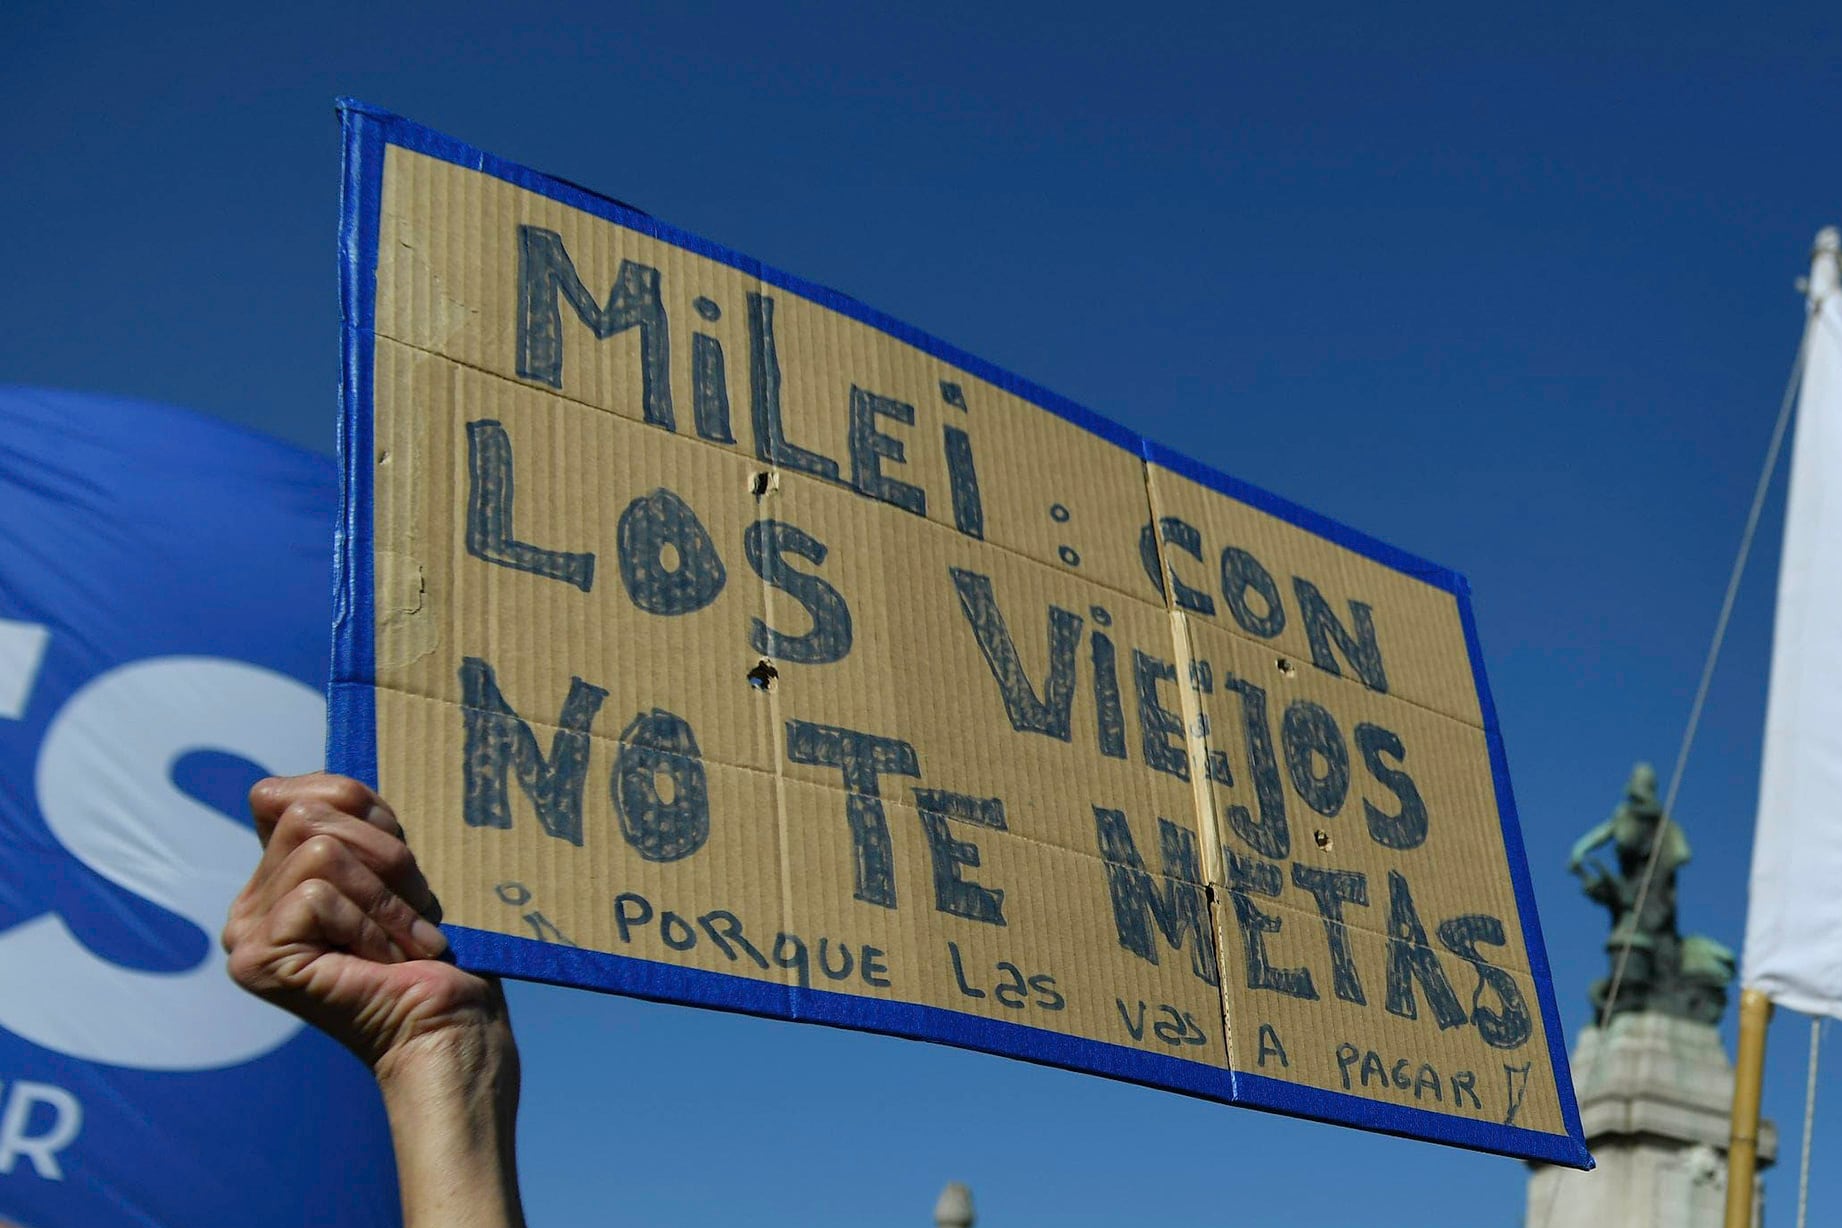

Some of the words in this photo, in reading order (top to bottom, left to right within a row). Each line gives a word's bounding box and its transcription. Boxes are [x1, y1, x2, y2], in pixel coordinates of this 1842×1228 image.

[465, 418, 853, 665] LOS
[1138, 516, 1390, 694] CON
[457, 655, 710, 863] NO
[785, 717, 1010, 927] TE
[1090, 802, 1534, 1050] METAS
[1255, 1023, 1290, 1068] A
[1335, 1042, 1484, 1111] PAGAR
